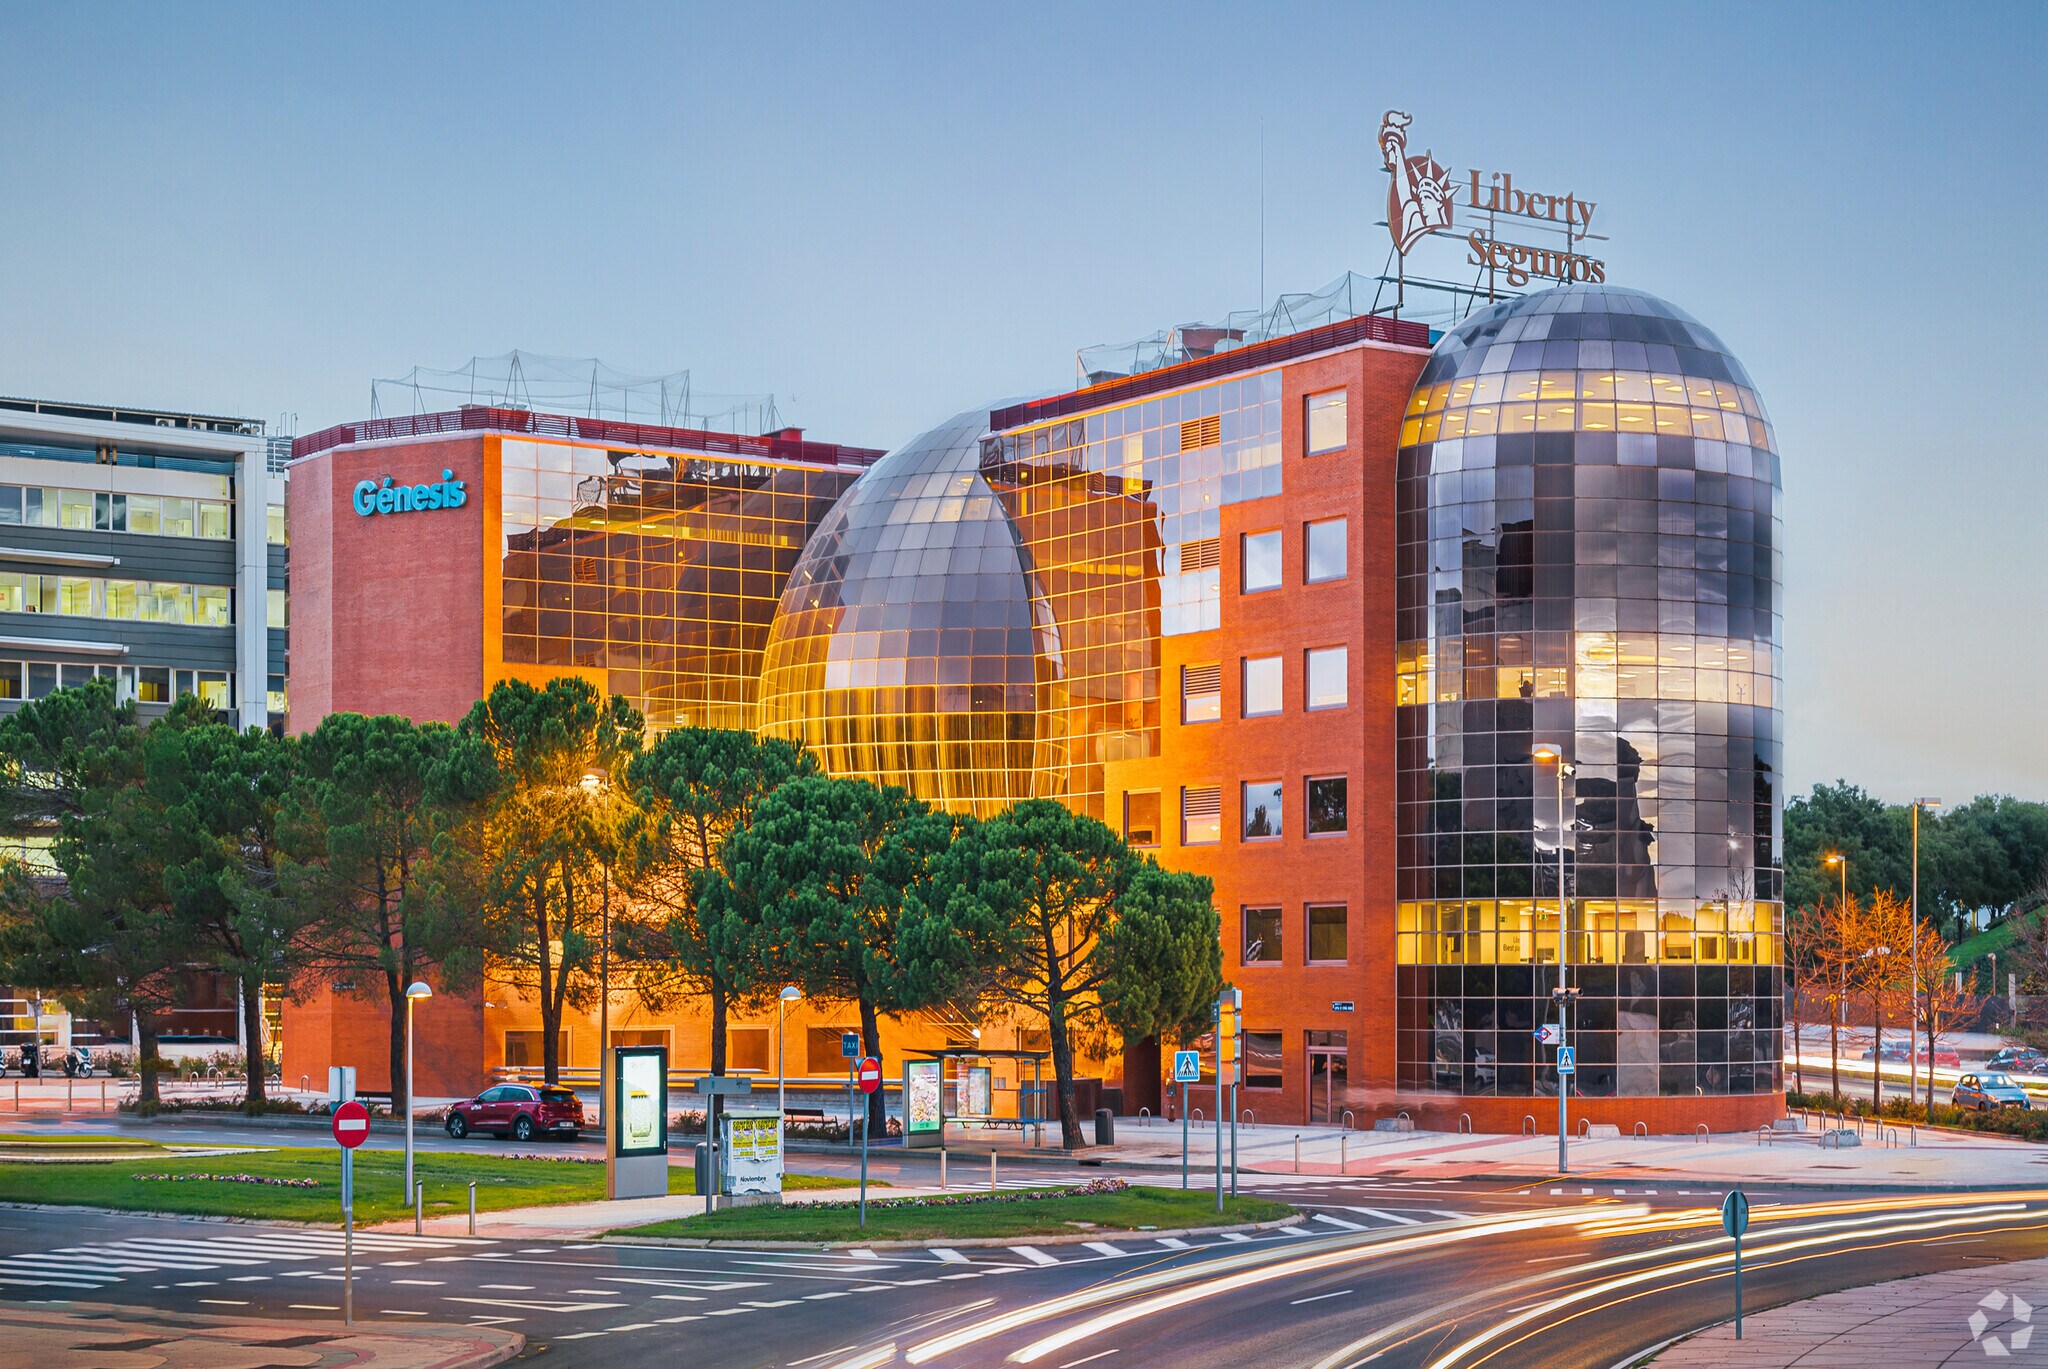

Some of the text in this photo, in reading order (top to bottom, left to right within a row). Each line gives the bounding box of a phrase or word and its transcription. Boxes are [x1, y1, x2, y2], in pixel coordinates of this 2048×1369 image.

[1467, 169, 1598, 241] Liberty
[1467, 228, 1605, 287] Seguros
[353, 468, 467, 516] Génesis
[843, 1042, 858, 1050] TAXI
